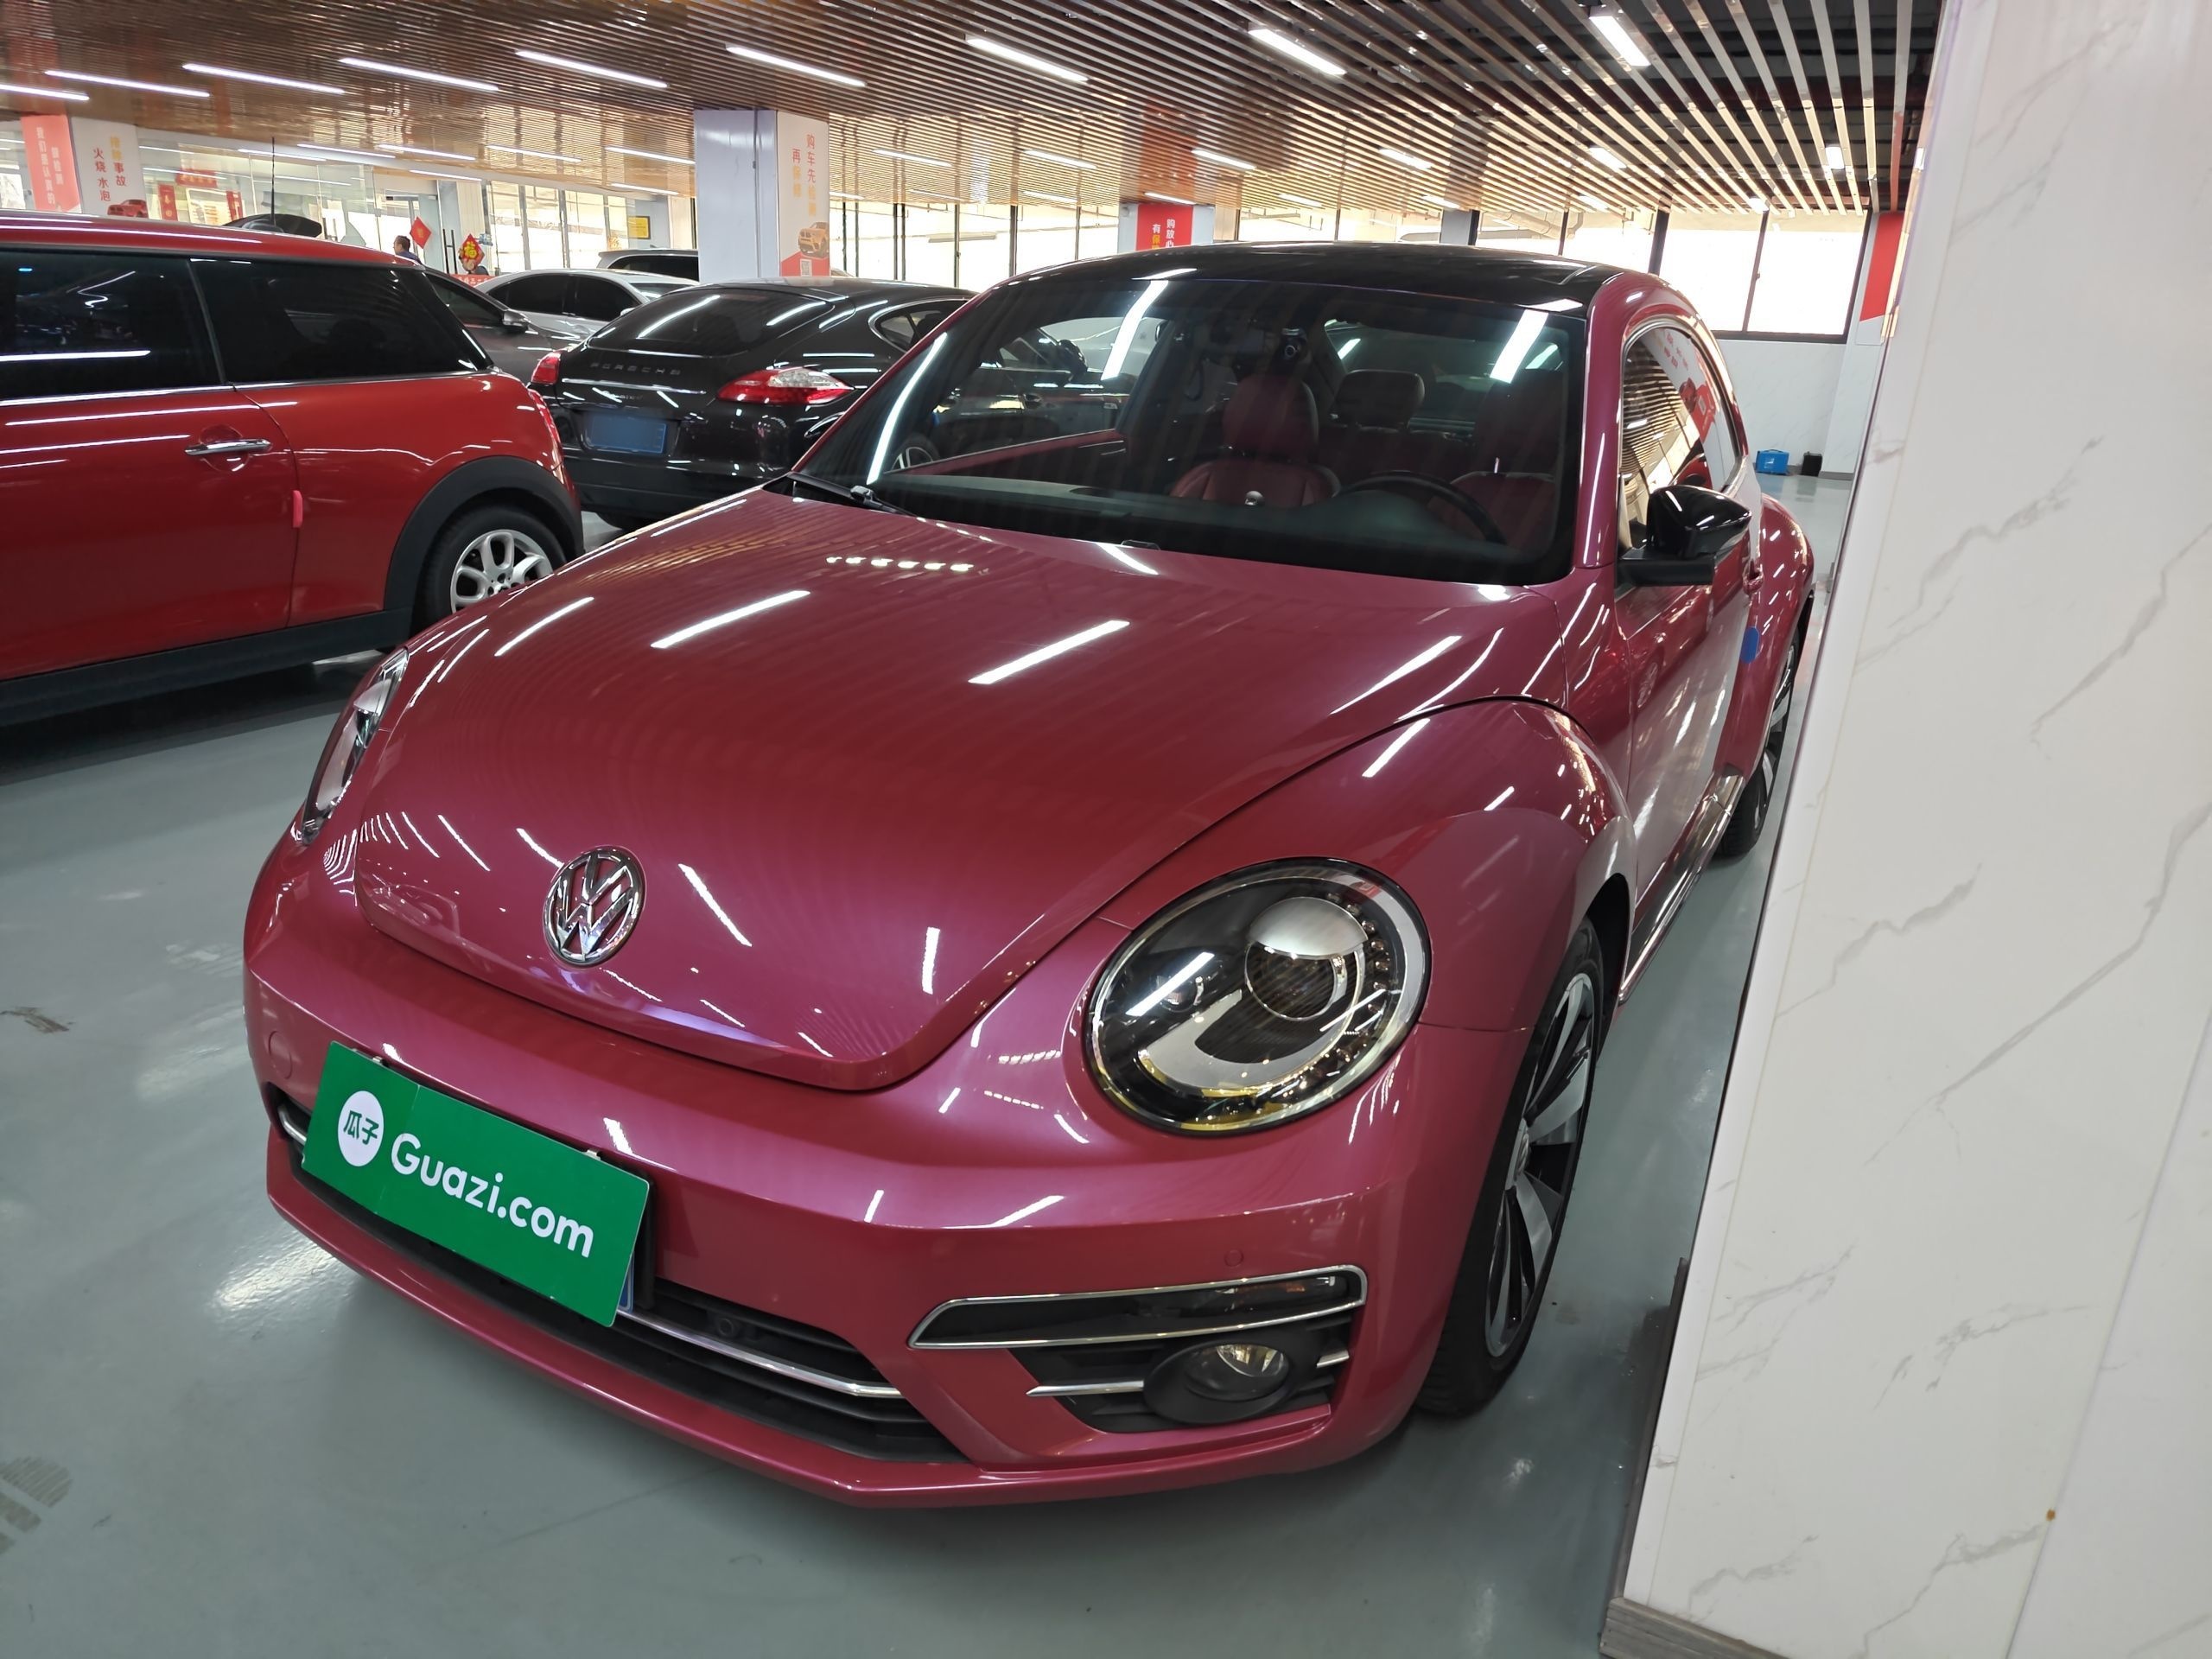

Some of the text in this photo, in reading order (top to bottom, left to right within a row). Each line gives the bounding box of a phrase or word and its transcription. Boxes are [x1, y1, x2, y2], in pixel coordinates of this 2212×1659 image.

[464, 241, 477, 259] 福
[590, 362, 682, 375] PORSCHE
[342, 1109, 380, 1146] 瓜子
[391, 1132, 594, 1258] Guazi.com
